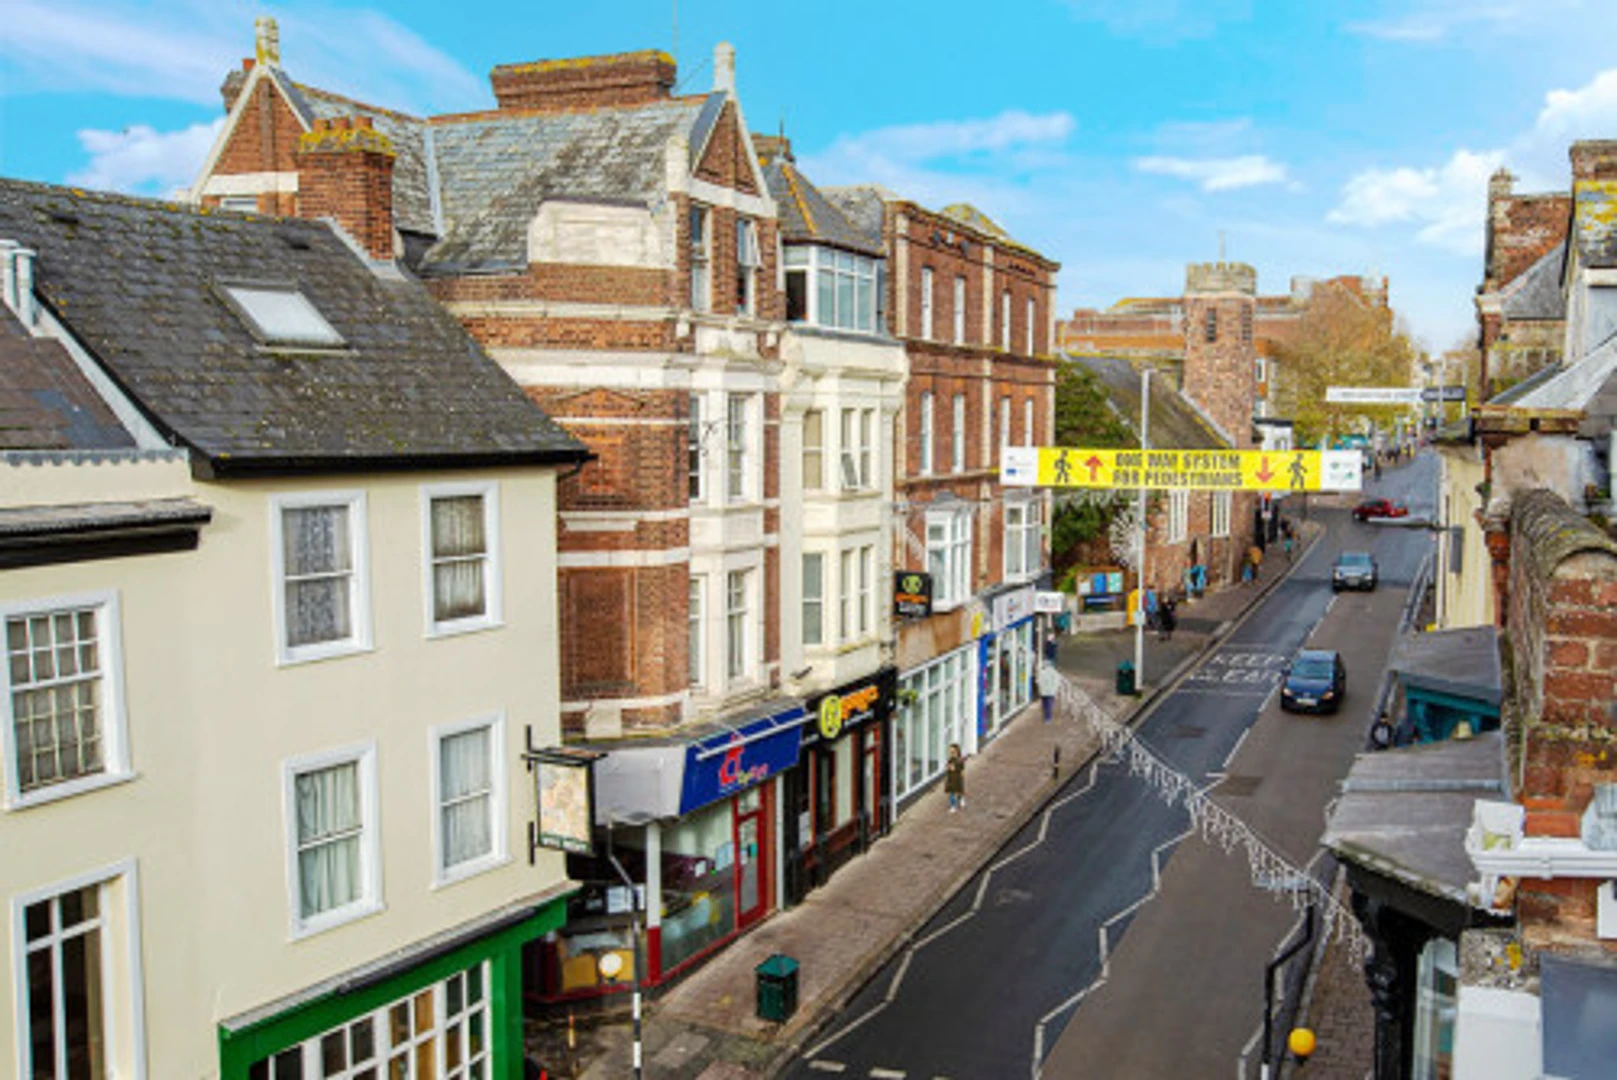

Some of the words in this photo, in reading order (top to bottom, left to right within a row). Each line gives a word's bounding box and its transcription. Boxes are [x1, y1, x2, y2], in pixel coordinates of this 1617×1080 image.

[1183, 453, 1239, 470] SYSTEM
[1112, 469, 1140, 484] FOR
[1145, 471, 1242, 487] PEDESTRIANS
